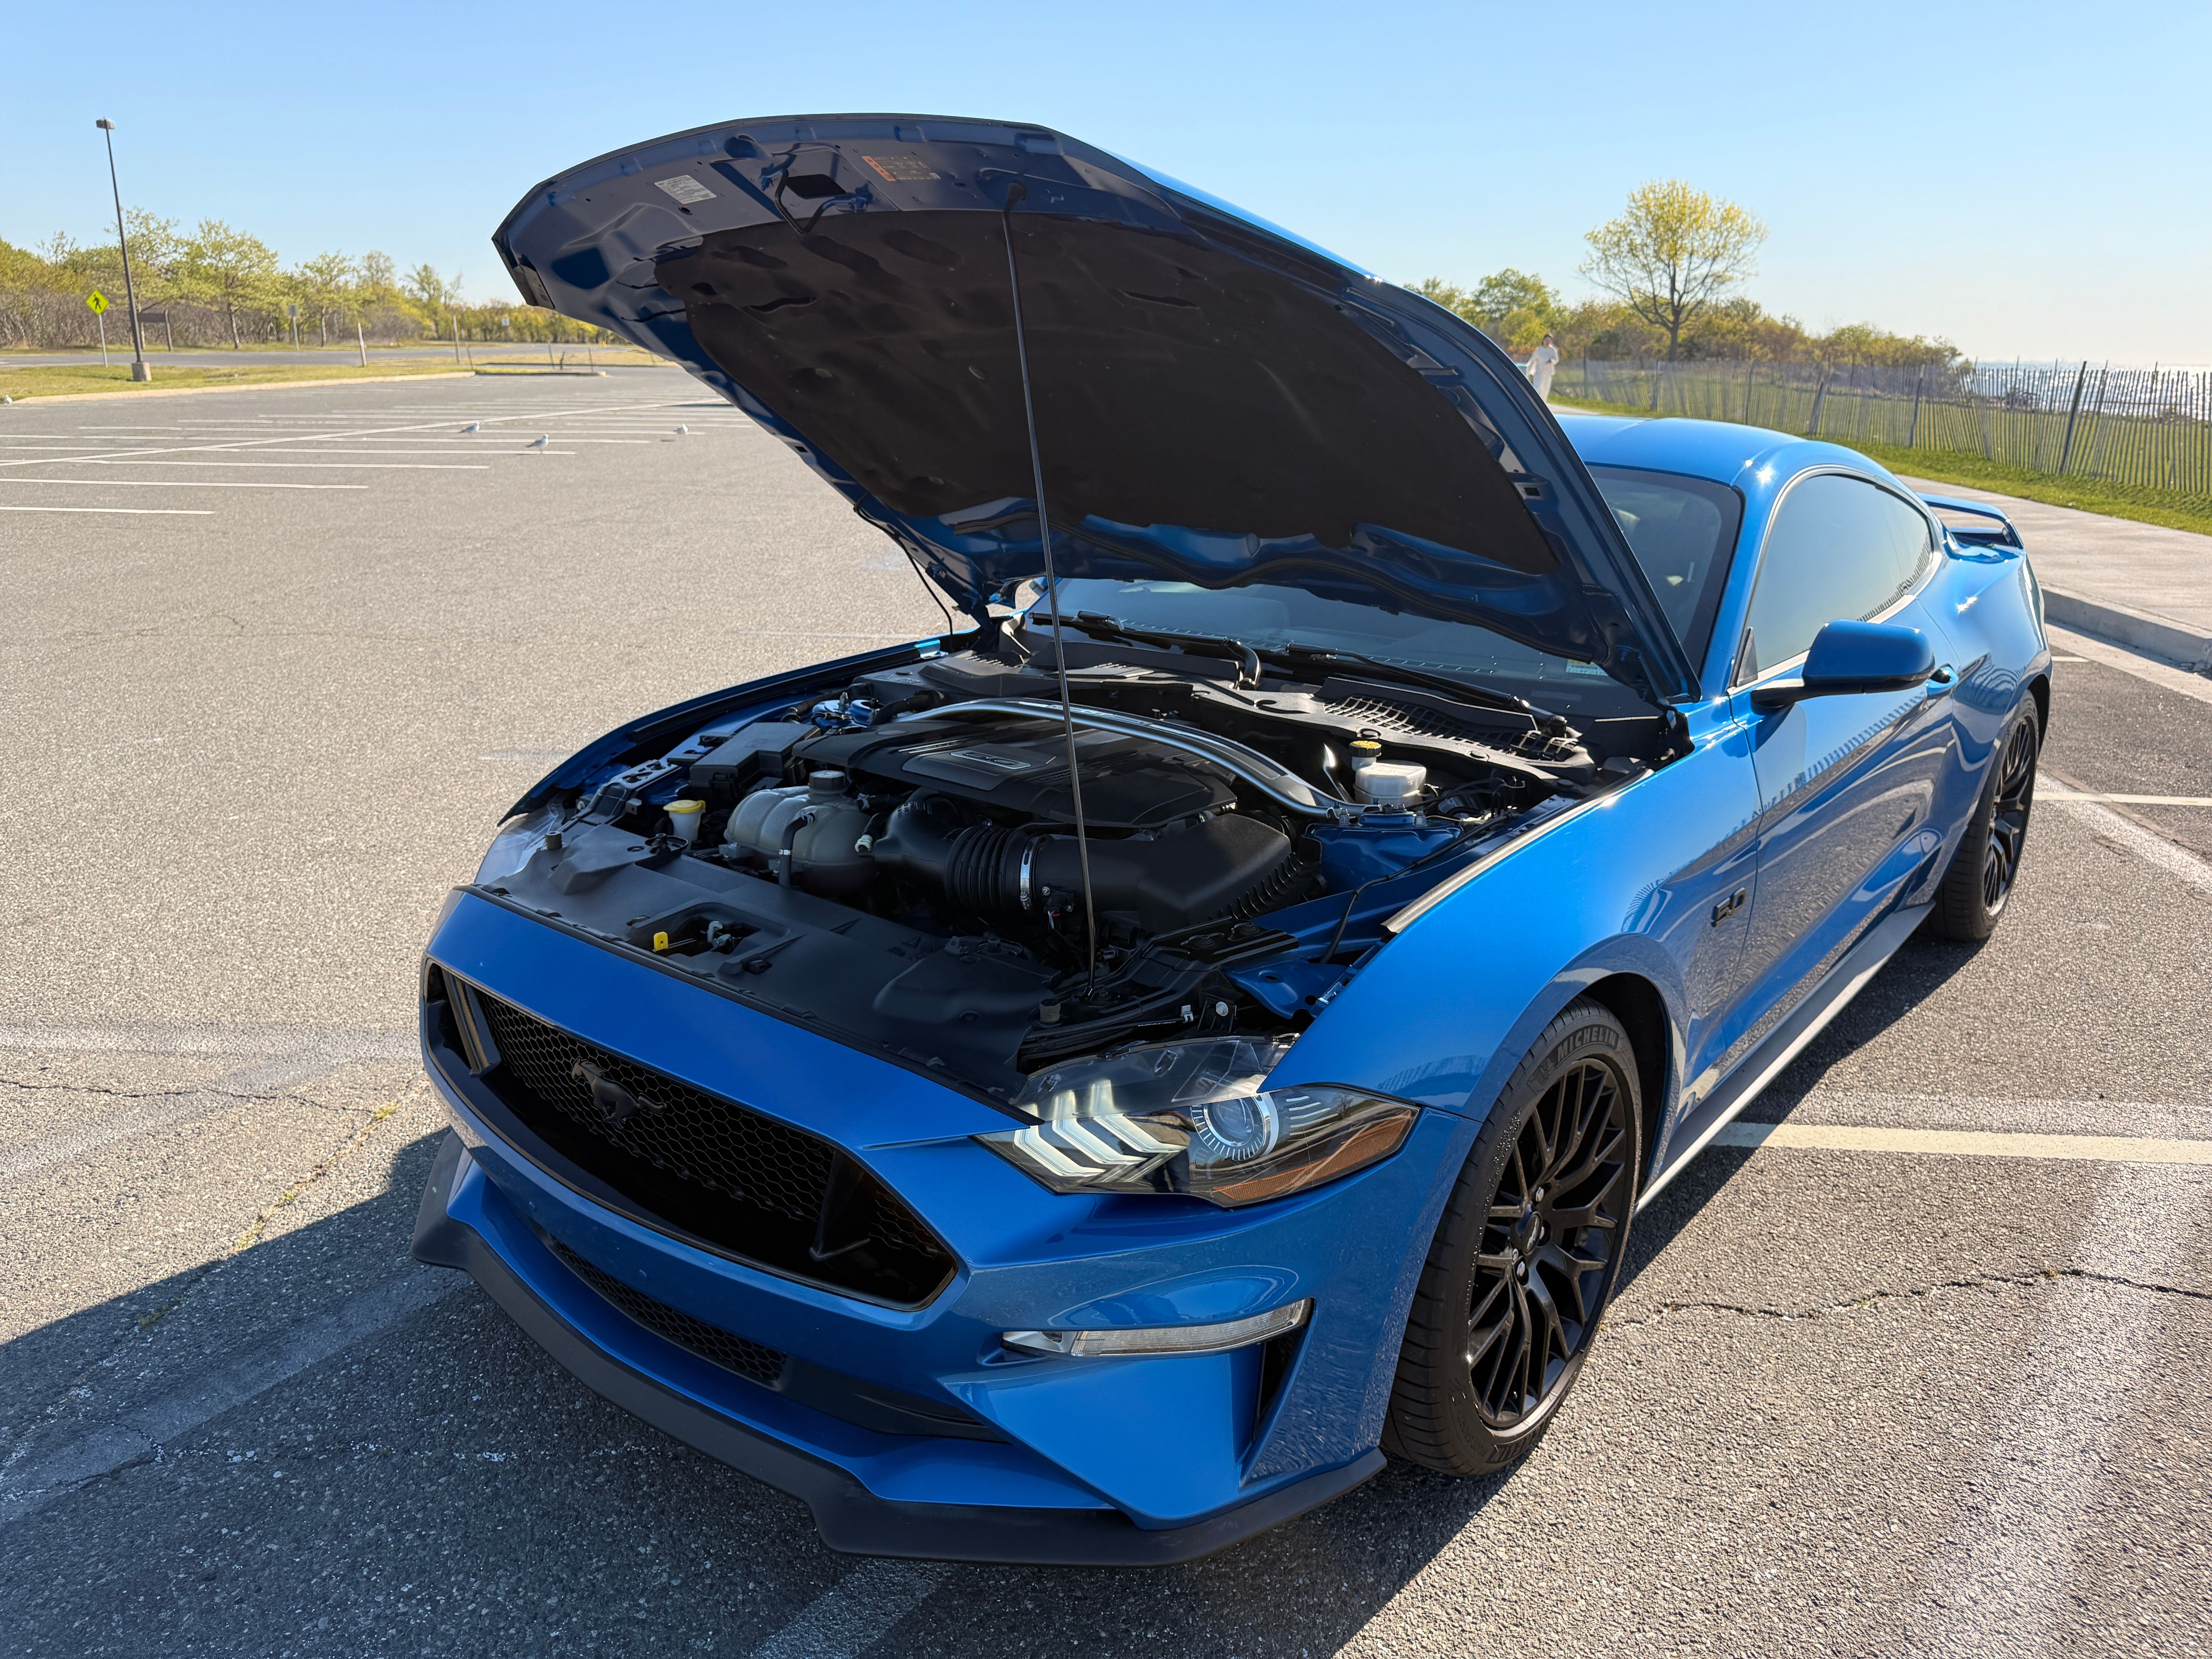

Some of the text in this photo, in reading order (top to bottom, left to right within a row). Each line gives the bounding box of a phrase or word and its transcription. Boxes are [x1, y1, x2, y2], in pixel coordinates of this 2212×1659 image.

[1711, 887, 1747, 927] 5.0
[1557, 1027, 1616, 1063] MICHELIN
[1457, 1416, 1474, 1443] SPORT
